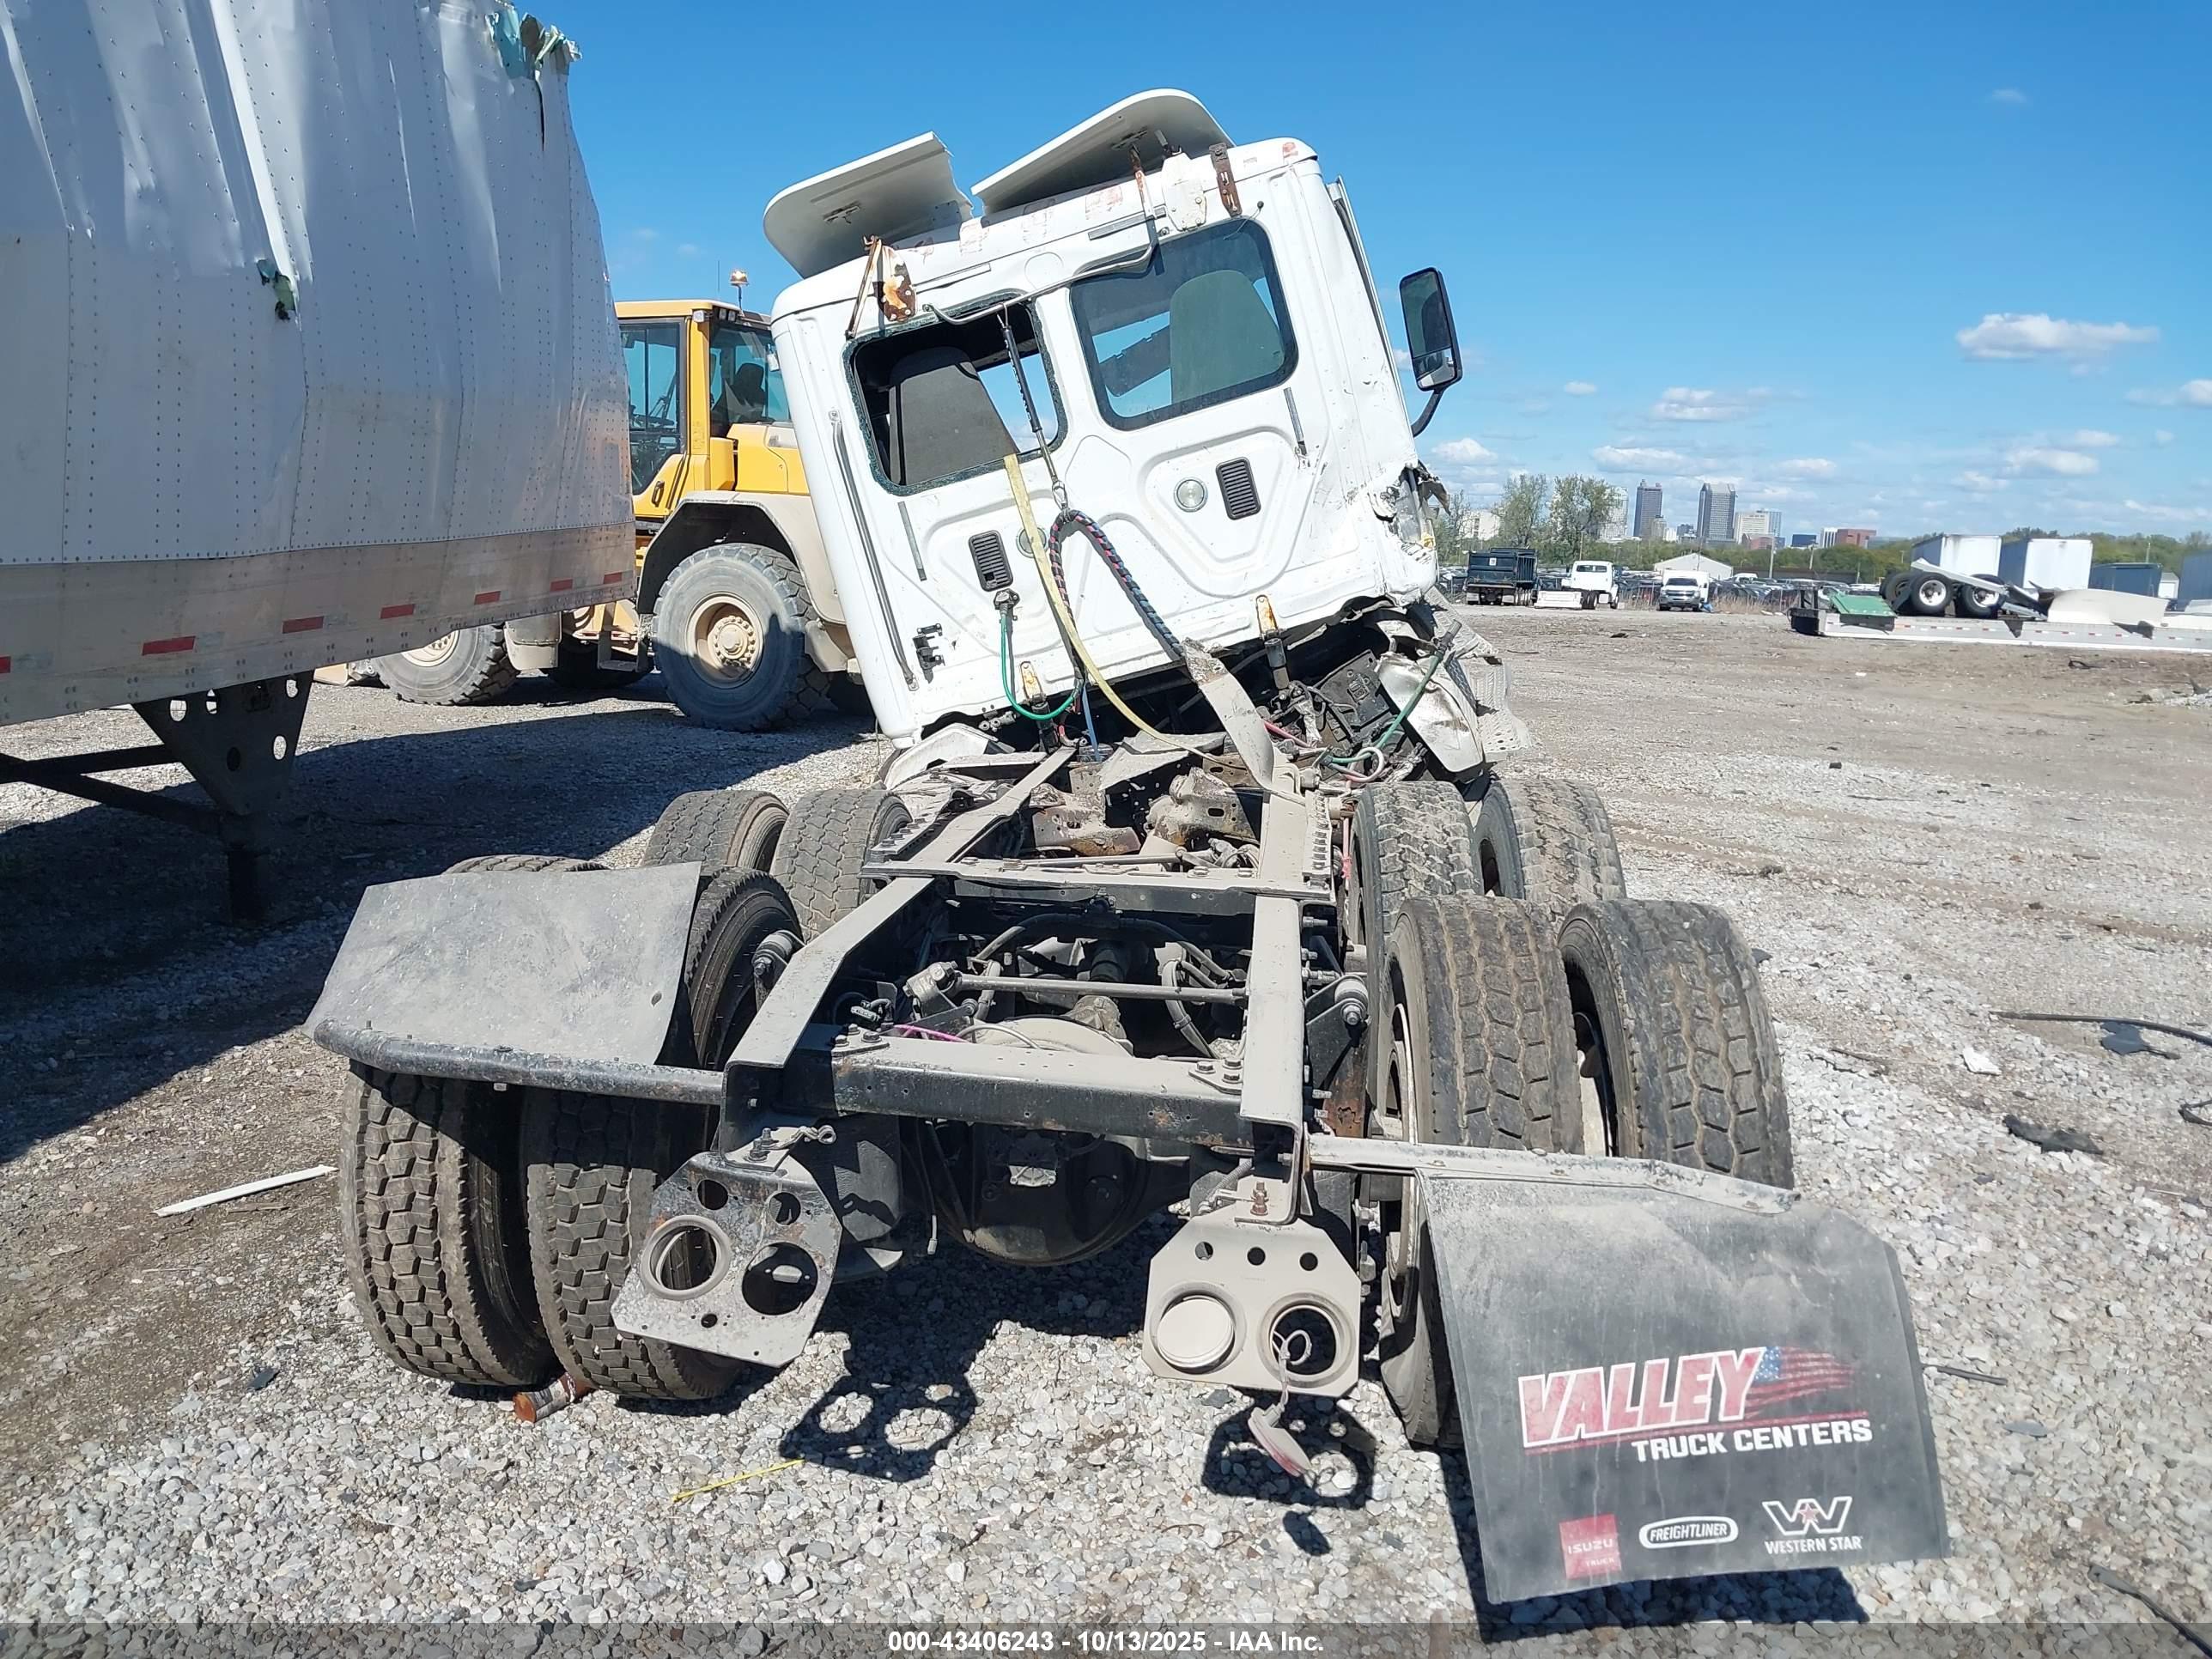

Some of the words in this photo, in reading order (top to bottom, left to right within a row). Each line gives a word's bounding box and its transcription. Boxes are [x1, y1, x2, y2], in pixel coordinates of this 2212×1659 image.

[1518, 1346, 1766, 1449] VALLEY
[1632, 1431, 1727, 1462] TRUCK
[1733, 1419, 1873, 1453] CENTERS
[1650, 1522, 1728, 1543] FREIGHTLINER
[1567, 1538, 1614, 1555] ISUZU
[1764, 1538, 1827, 1555] WESTERN
[1828, 1535, 1863, 1552] STAR
[1585, 1557, 1615, 1567] TRUCK
